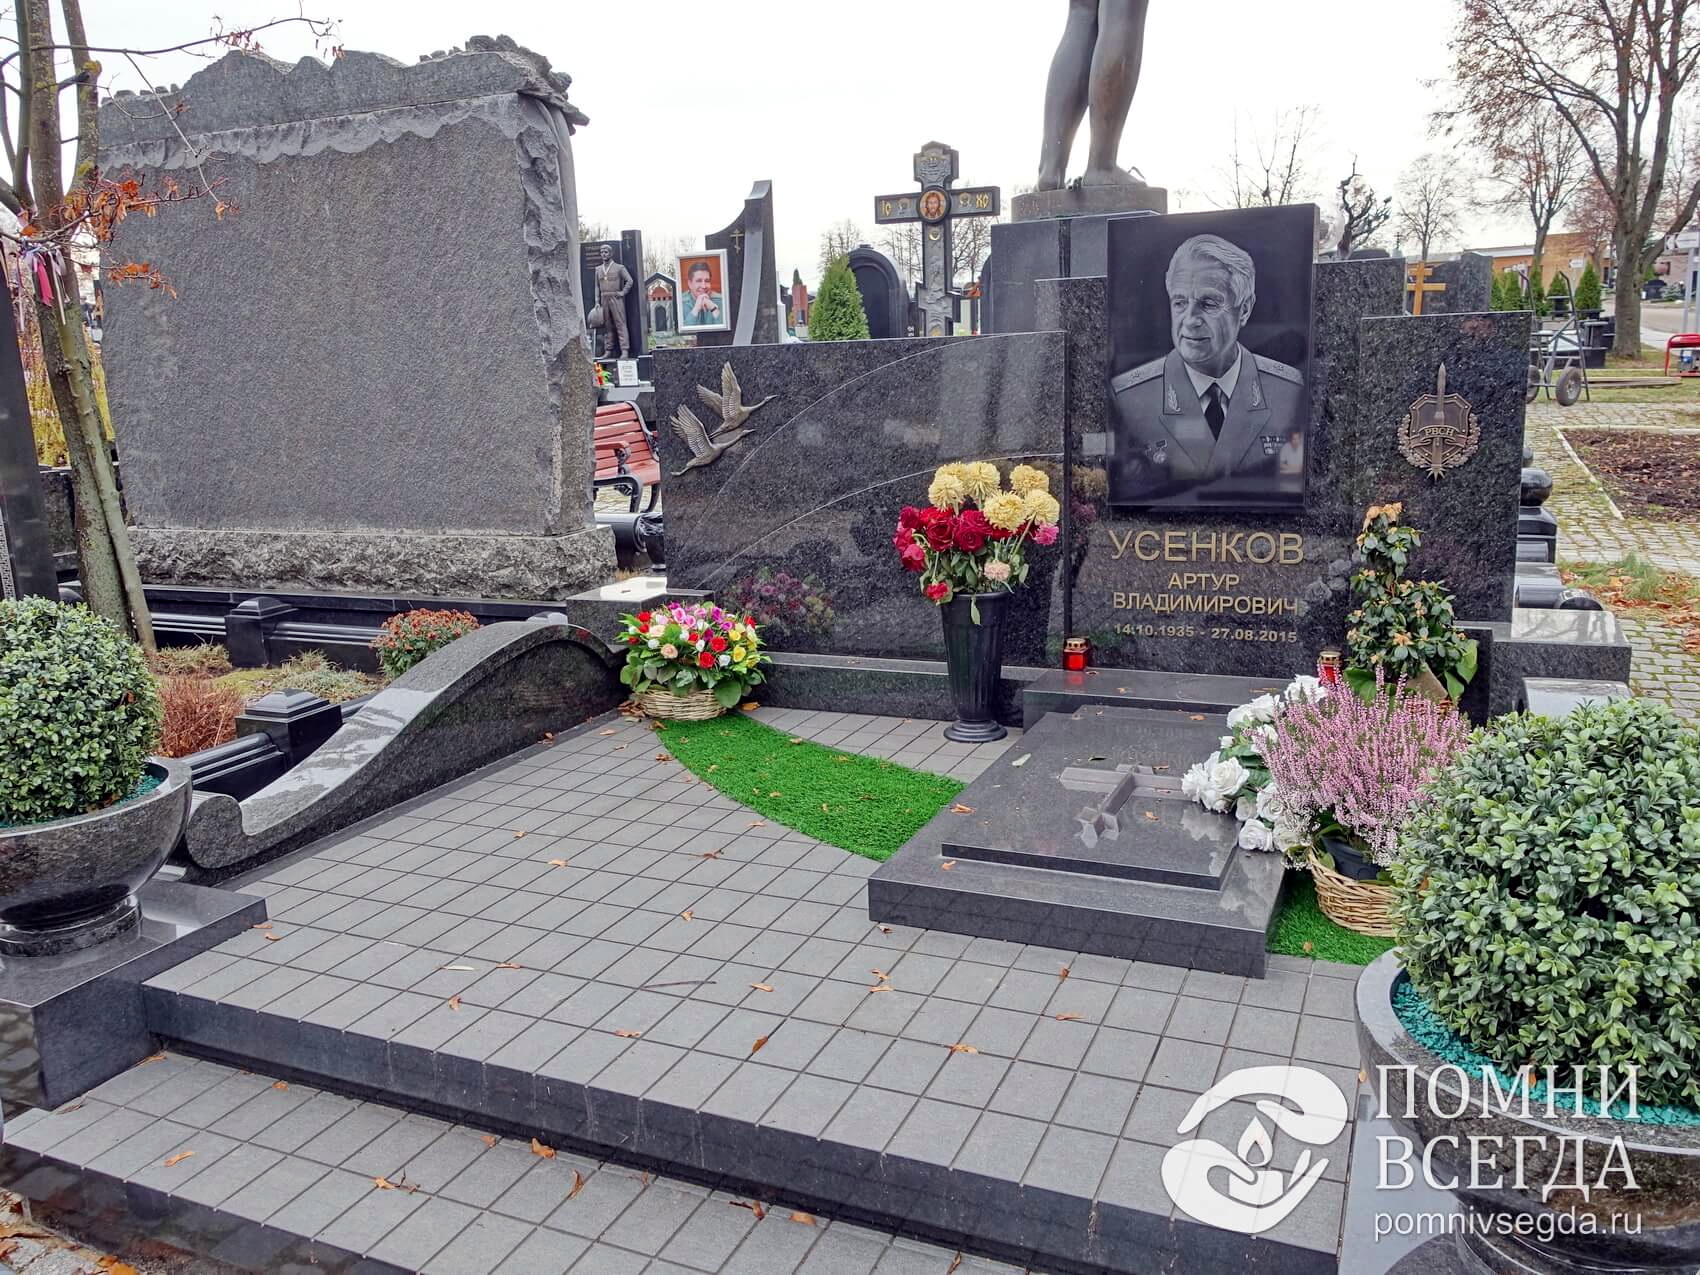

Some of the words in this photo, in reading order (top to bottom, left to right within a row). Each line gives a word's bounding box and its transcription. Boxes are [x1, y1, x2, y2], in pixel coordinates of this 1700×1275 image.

[1108, 529, 1304, 565] УСЕНКОВ
[1167, 573, 1240, 591] АРТУР
[1113, 592, 1299, 615] ВЛАДИМИРОВИЧ
[1114, 623, 1195, 637] 14.10.1935
[1211, 628, 1297, 643] 27.08.2015
